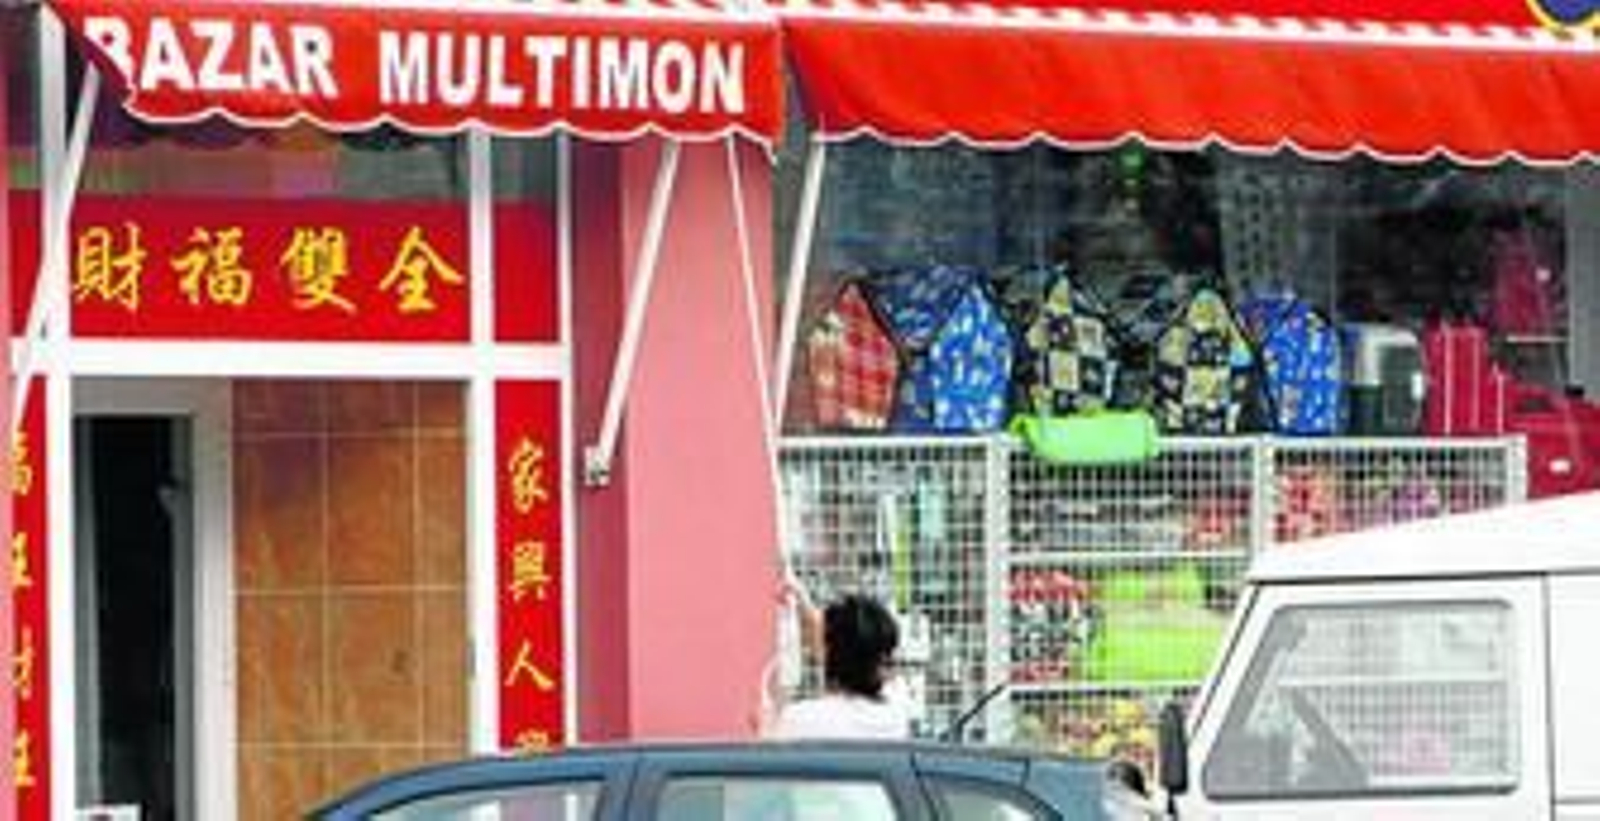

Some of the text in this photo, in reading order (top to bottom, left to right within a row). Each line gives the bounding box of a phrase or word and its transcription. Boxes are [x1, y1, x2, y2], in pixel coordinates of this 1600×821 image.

[378, 30, 745, 114] MULTIMON
[73, 221, 465, 312] 財福雙全
